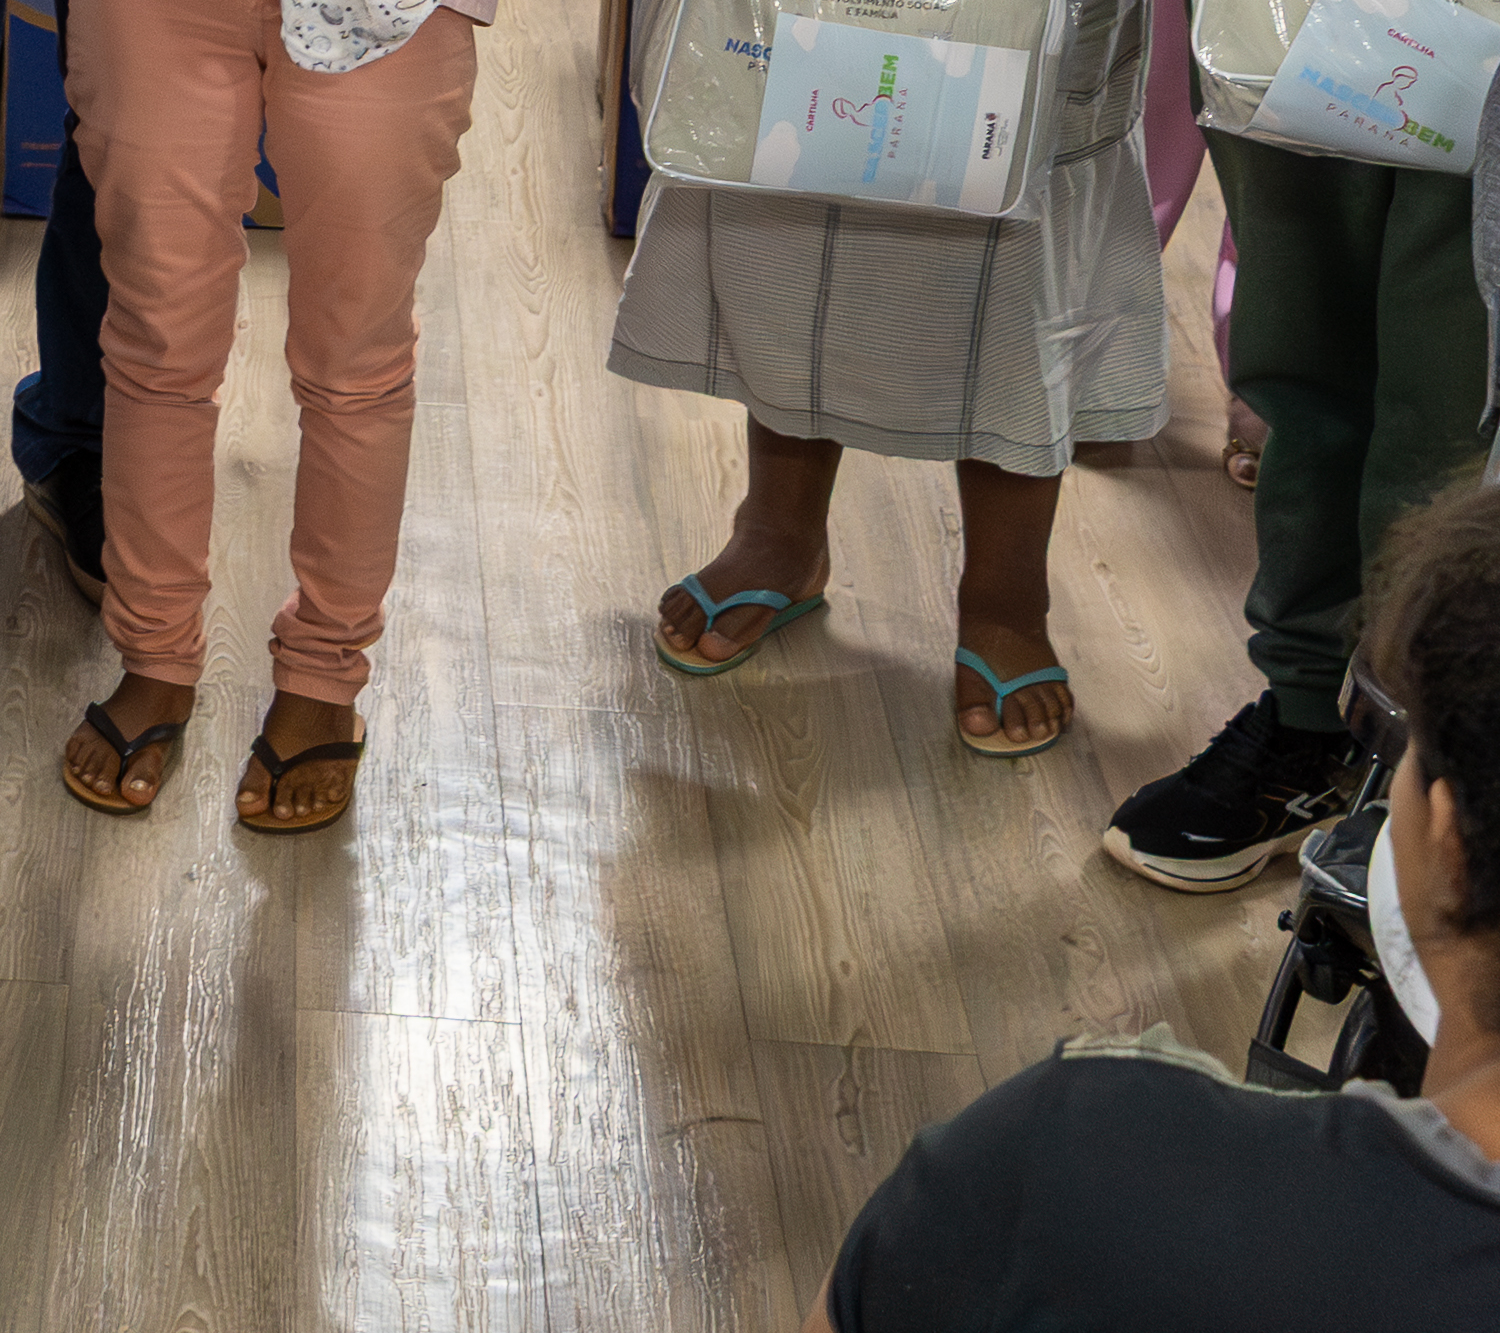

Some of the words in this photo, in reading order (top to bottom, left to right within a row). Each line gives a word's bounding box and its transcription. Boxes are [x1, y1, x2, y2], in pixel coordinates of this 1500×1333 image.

[724, 37, 772, 61] NASC
[877, 54, 900, 96] BEM
[1402, 118, 1456, 153] BEM
